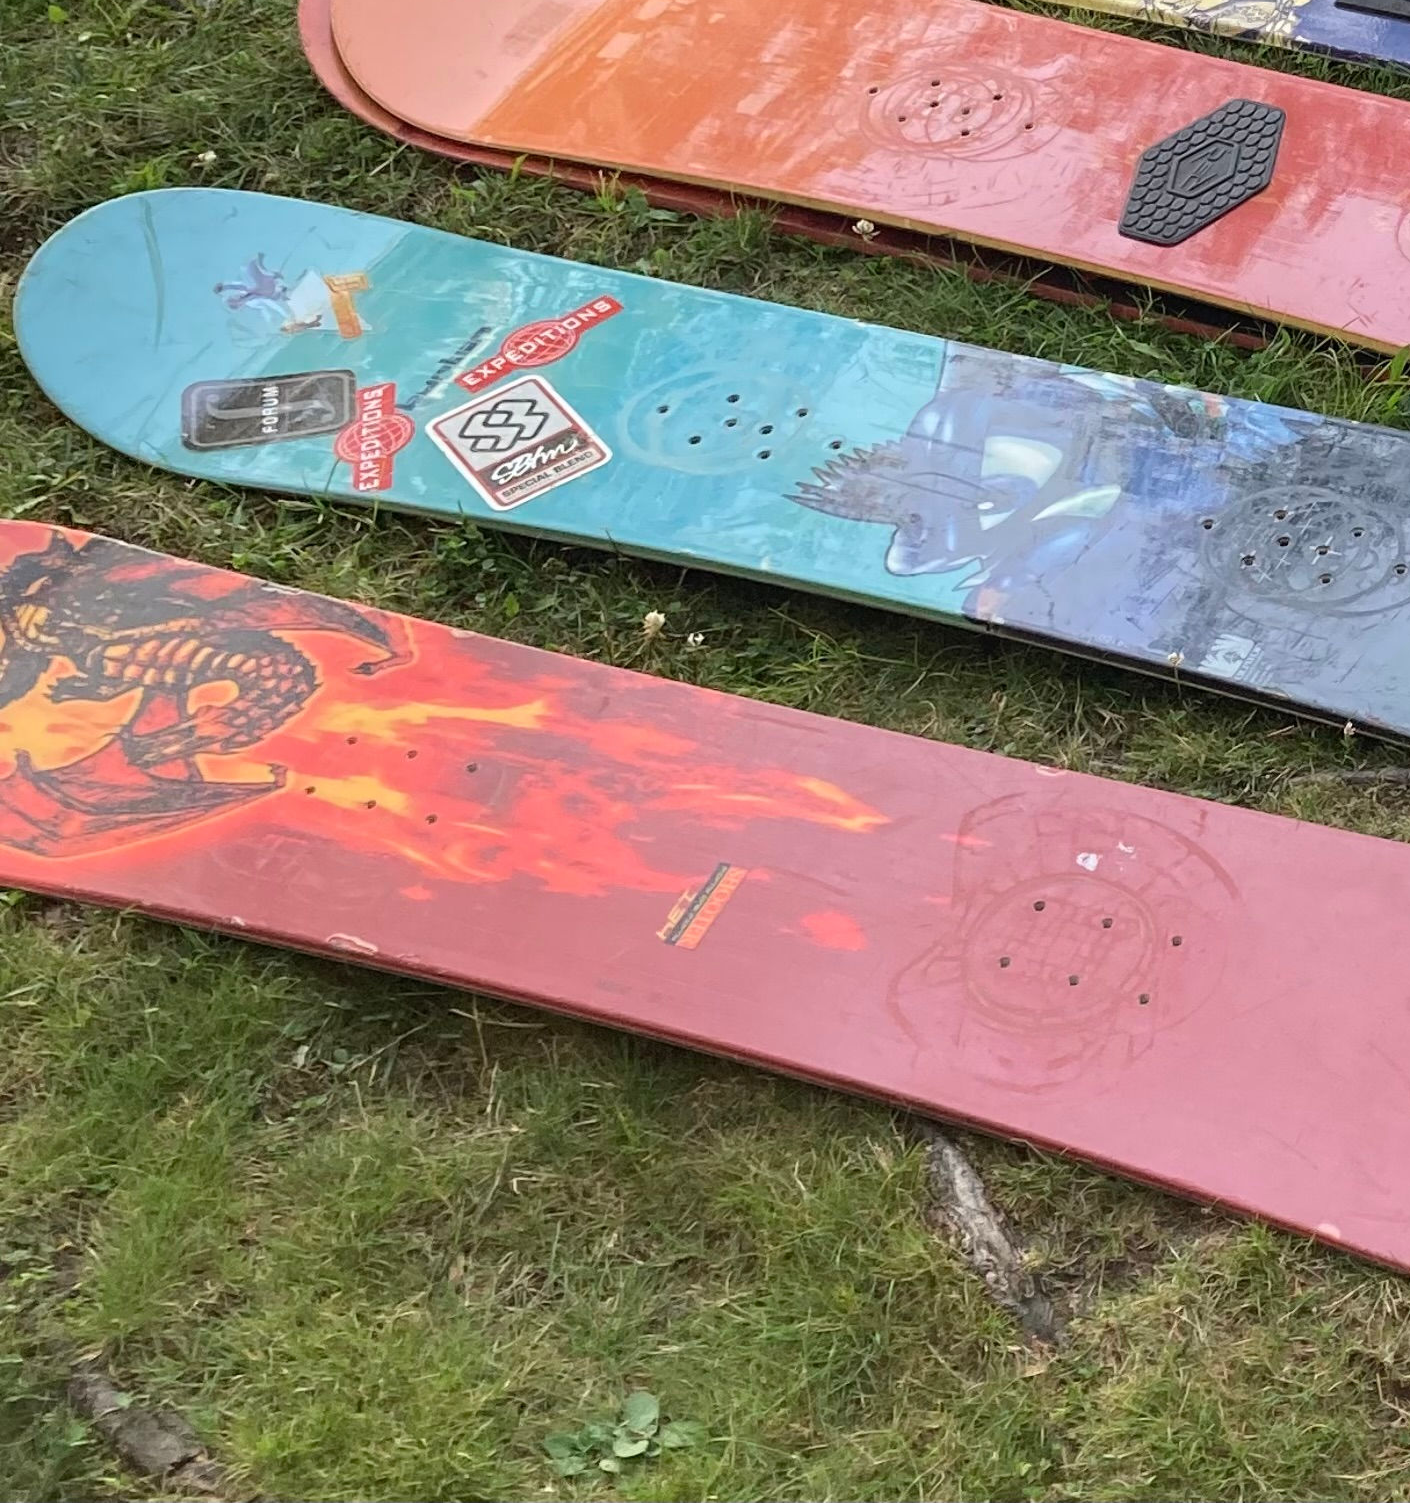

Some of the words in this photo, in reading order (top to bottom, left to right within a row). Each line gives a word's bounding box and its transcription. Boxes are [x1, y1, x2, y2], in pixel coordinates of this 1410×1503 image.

[462, 299, 612, 388] EXPEDITIONS
[261, 385, 280, 434] FORUM
[359, 388, 385, 492] EXPEDITIONS
[502, 470, 553, 498] SPECIAL
[553, 450, 593, 474] BLEND
